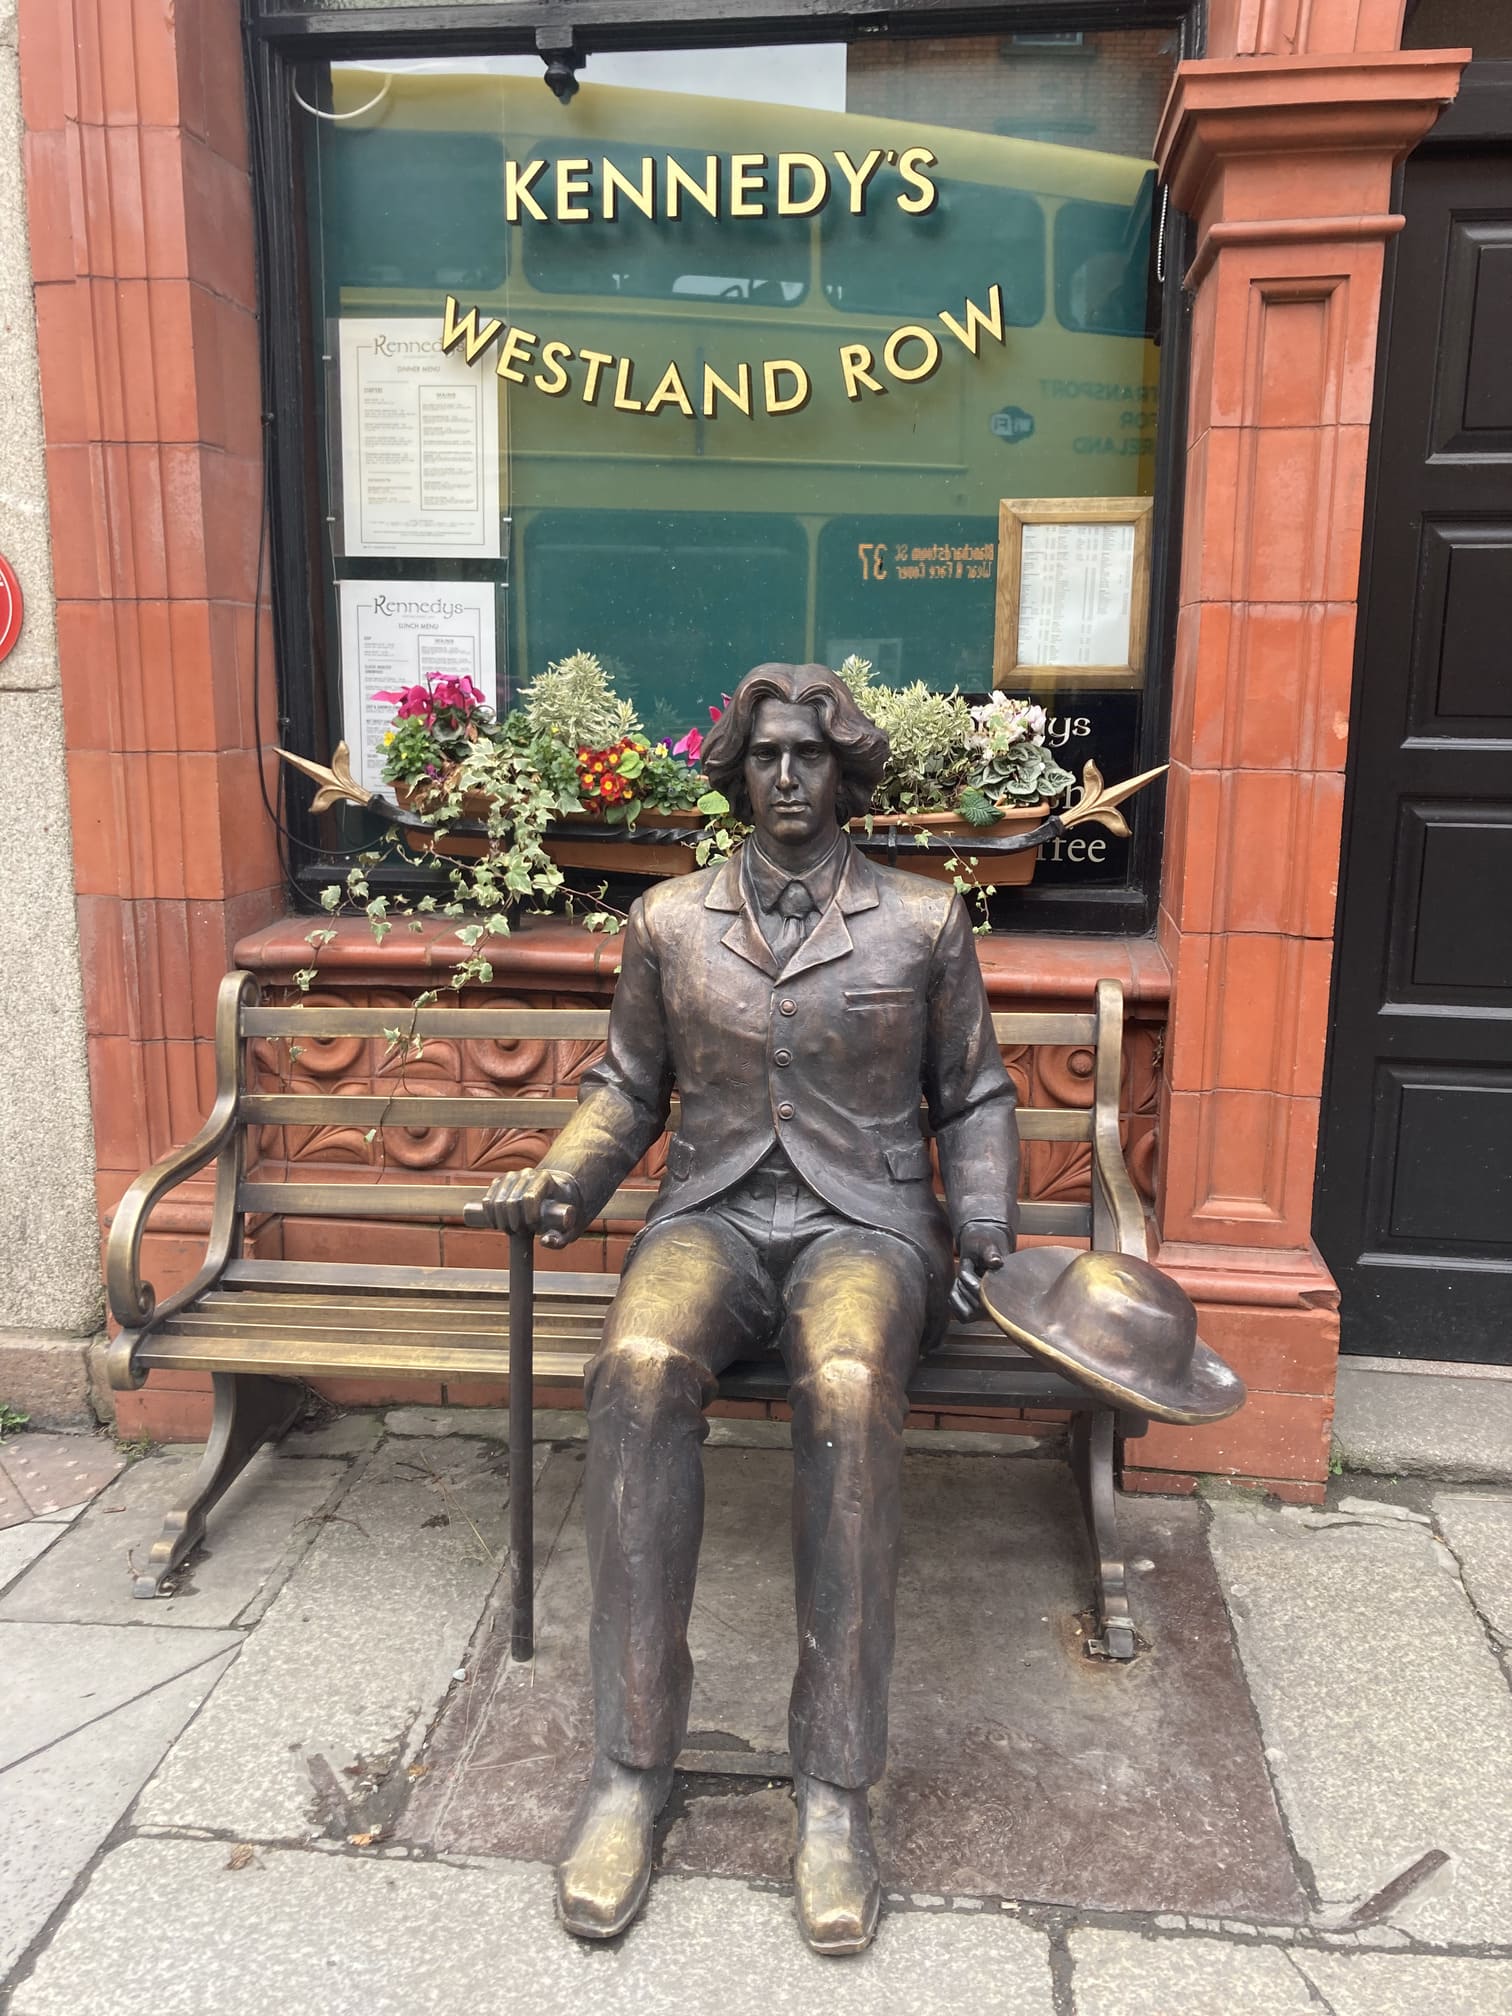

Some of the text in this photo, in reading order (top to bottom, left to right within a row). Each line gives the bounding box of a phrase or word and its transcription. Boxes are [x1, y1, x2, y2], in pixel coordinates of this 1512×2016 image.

[505, 147, 939, 225] KENNEDY'S
[374, 335, 465, 359] Kenneds
[441, 283, 1006, 417] WESTLAND ROW
[374, 595, 464, 620] Kennedys
